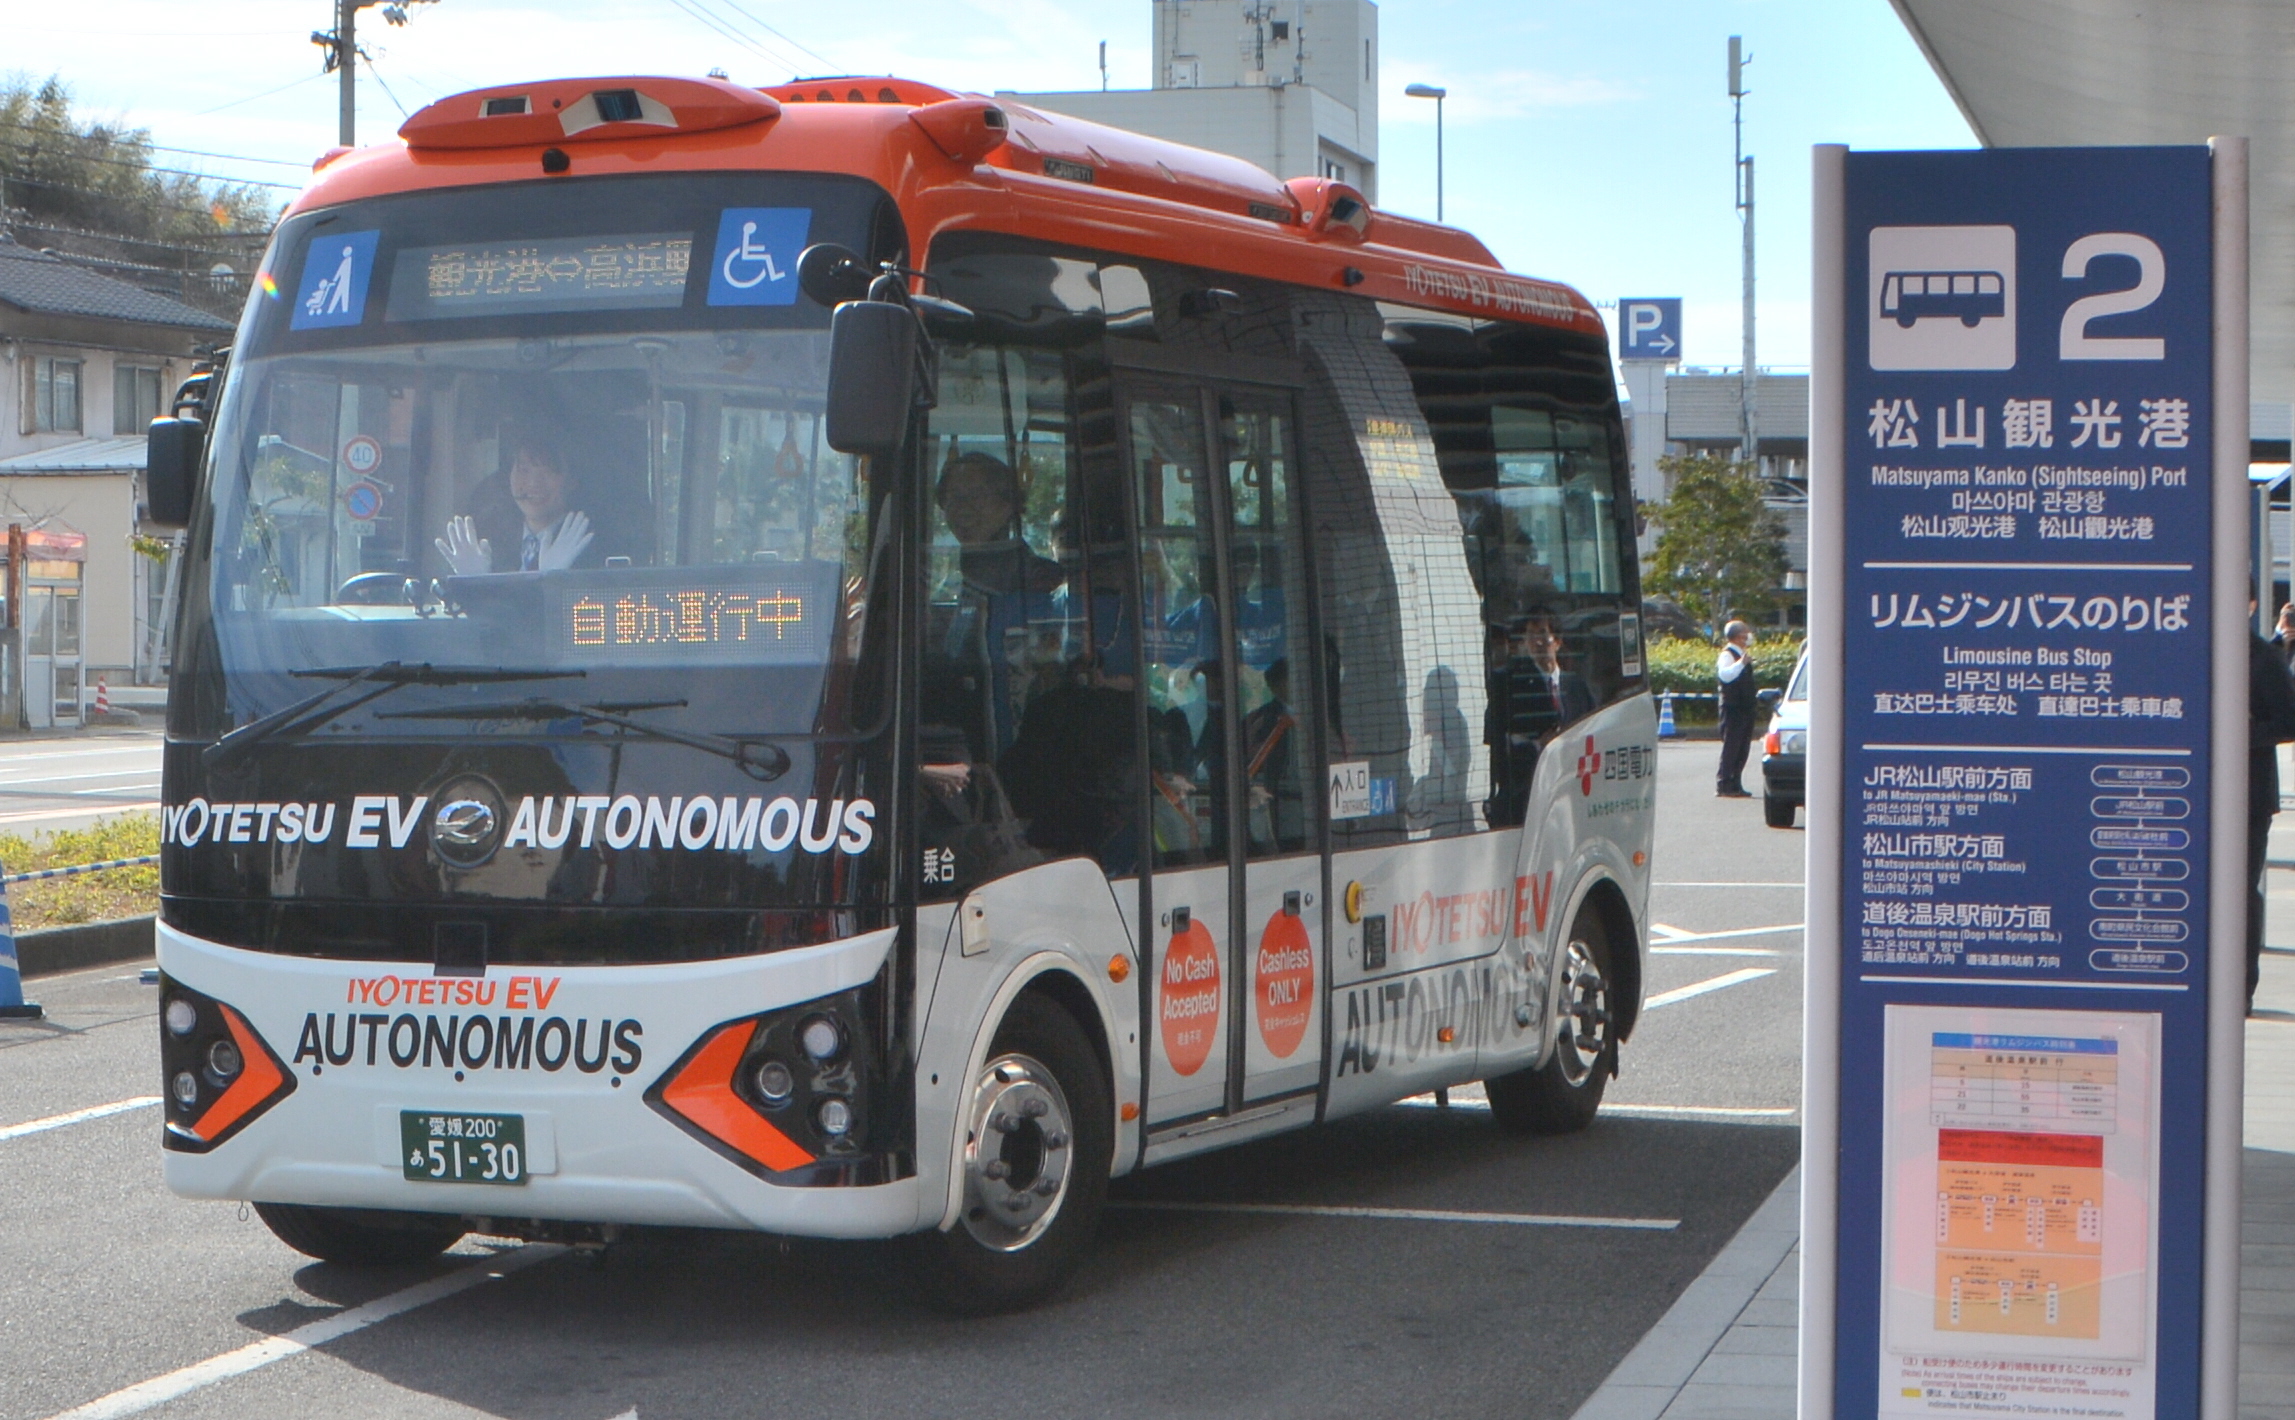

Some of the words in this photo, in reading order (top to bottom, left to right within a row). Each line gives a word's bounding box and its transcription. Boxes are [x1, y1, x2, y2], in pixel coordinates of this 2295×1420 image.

[1404, 264, 1467, 300] IYOTETSU
[1466, 273, 1490, 306] EV
[1493, 279, 1575, 322] AUTONOMOUS
[2060, 232, 2165, 360] 2
[1628, 304, 1663, 347] P
[1868, 398, 2191, 449] 松山観光港
[352, 445, 372, 463] 40
[1872, 467, 1969, 489] Matsuyama
[1974, 467, 2027, 486] Kanko
[2031, 467, 2147, 489] (Sightseeing)
[2151, 468, 2187, 487] Port
[1952, 491, 2036, 514] 마쓰야마
[2041, 491, 2106, 514] 관광항
[1901, 515, 2016, 538] 松山观光港
[2038, 517, 2154, 540] 松山觀光港
[572, 590, 802, 646] 自動運行中
[1871, 593, 2191, 631] リムジンバスのりば
[1943, 647, 2032, 666] Limousine
[2037, 648, 2068, 666] Bus
[2073, 649, 2112, 670] Stop
[1944, 671, 2000, 692] 리무진
[2006, 672, 2044, 691] 버스
[2050, 673, 2087, 692] 타는
[2093, 672, 2113, 693] 곳
[1873, 693, 2018, 716] 直达巴士乘车处
[1604, 745, 1652, 780] 四国電力
[1345, 769, 1366, 791] 入口
[1864, 765, 2033, 790] JR松山駅前方面
[1863, 789, 1873, 800] to
[1875, 790, 1888, 800] JR
[161, 797, 336, 848] IYOTETSU
[346, 796, 429, 848] EV
[504, 795, 875, 854] AUTONOMOUS
[1863, 832, 2005, 859] 松山市駅方面
[923, 846, 955, 884] 乗合
[1862, 858, 1872, 869] to
[1962, 860, 1985, 873] (City
[1987, 861, 2026, 873] Station)
[1391, 890, 1507, 954] IYOTETSU
[1513, 870, 1554, 939] EV
[1863, 902, 2051, 929] 道後温泉駅前方面
[1861, 927, 1871, 937] to
[1166, 958, 1182, 984] No
[1185, 953, 1215, 982] Cash
[1259, 946, 1309, 975] Cashless
[347, 975, 497, 1007] IYOTETSU
[505, 976, 561, 1010] EV
[1163, 987, 1217, 1021] Accepted
[1268, 977, 1301, 1006] ONLY
[293, 1012, 643, 1075] AUTONOMOUS
[409, 1147, 425, 1168] あ
[427, 1139, 520, 1180] 51-30
